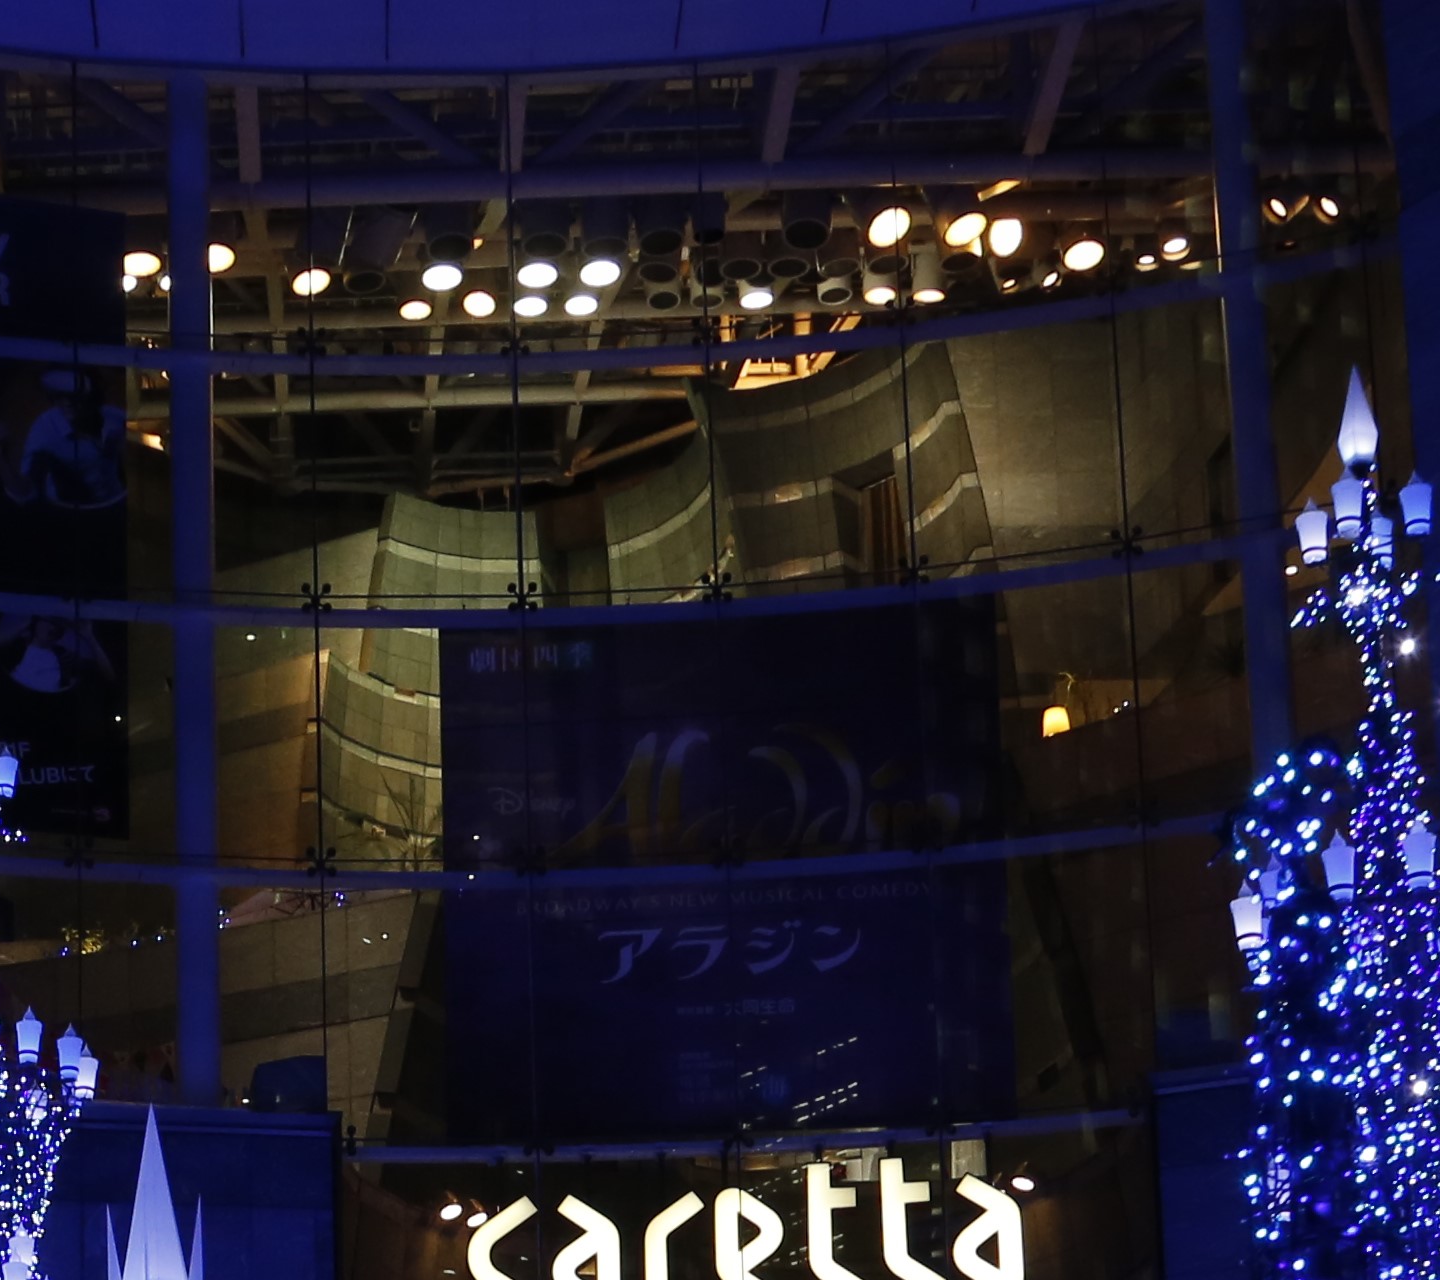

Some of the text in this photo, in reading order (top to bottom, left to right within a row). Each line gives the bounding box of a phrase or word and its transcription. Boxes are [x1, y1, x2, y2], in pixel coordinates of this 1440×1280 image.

[669, 891, 718, 910] NEW
[729, 886, 826, 907] MUSICAL
[836, 879, 935, 901] COMEDY
[597, 918, 862, 985] アラジン
